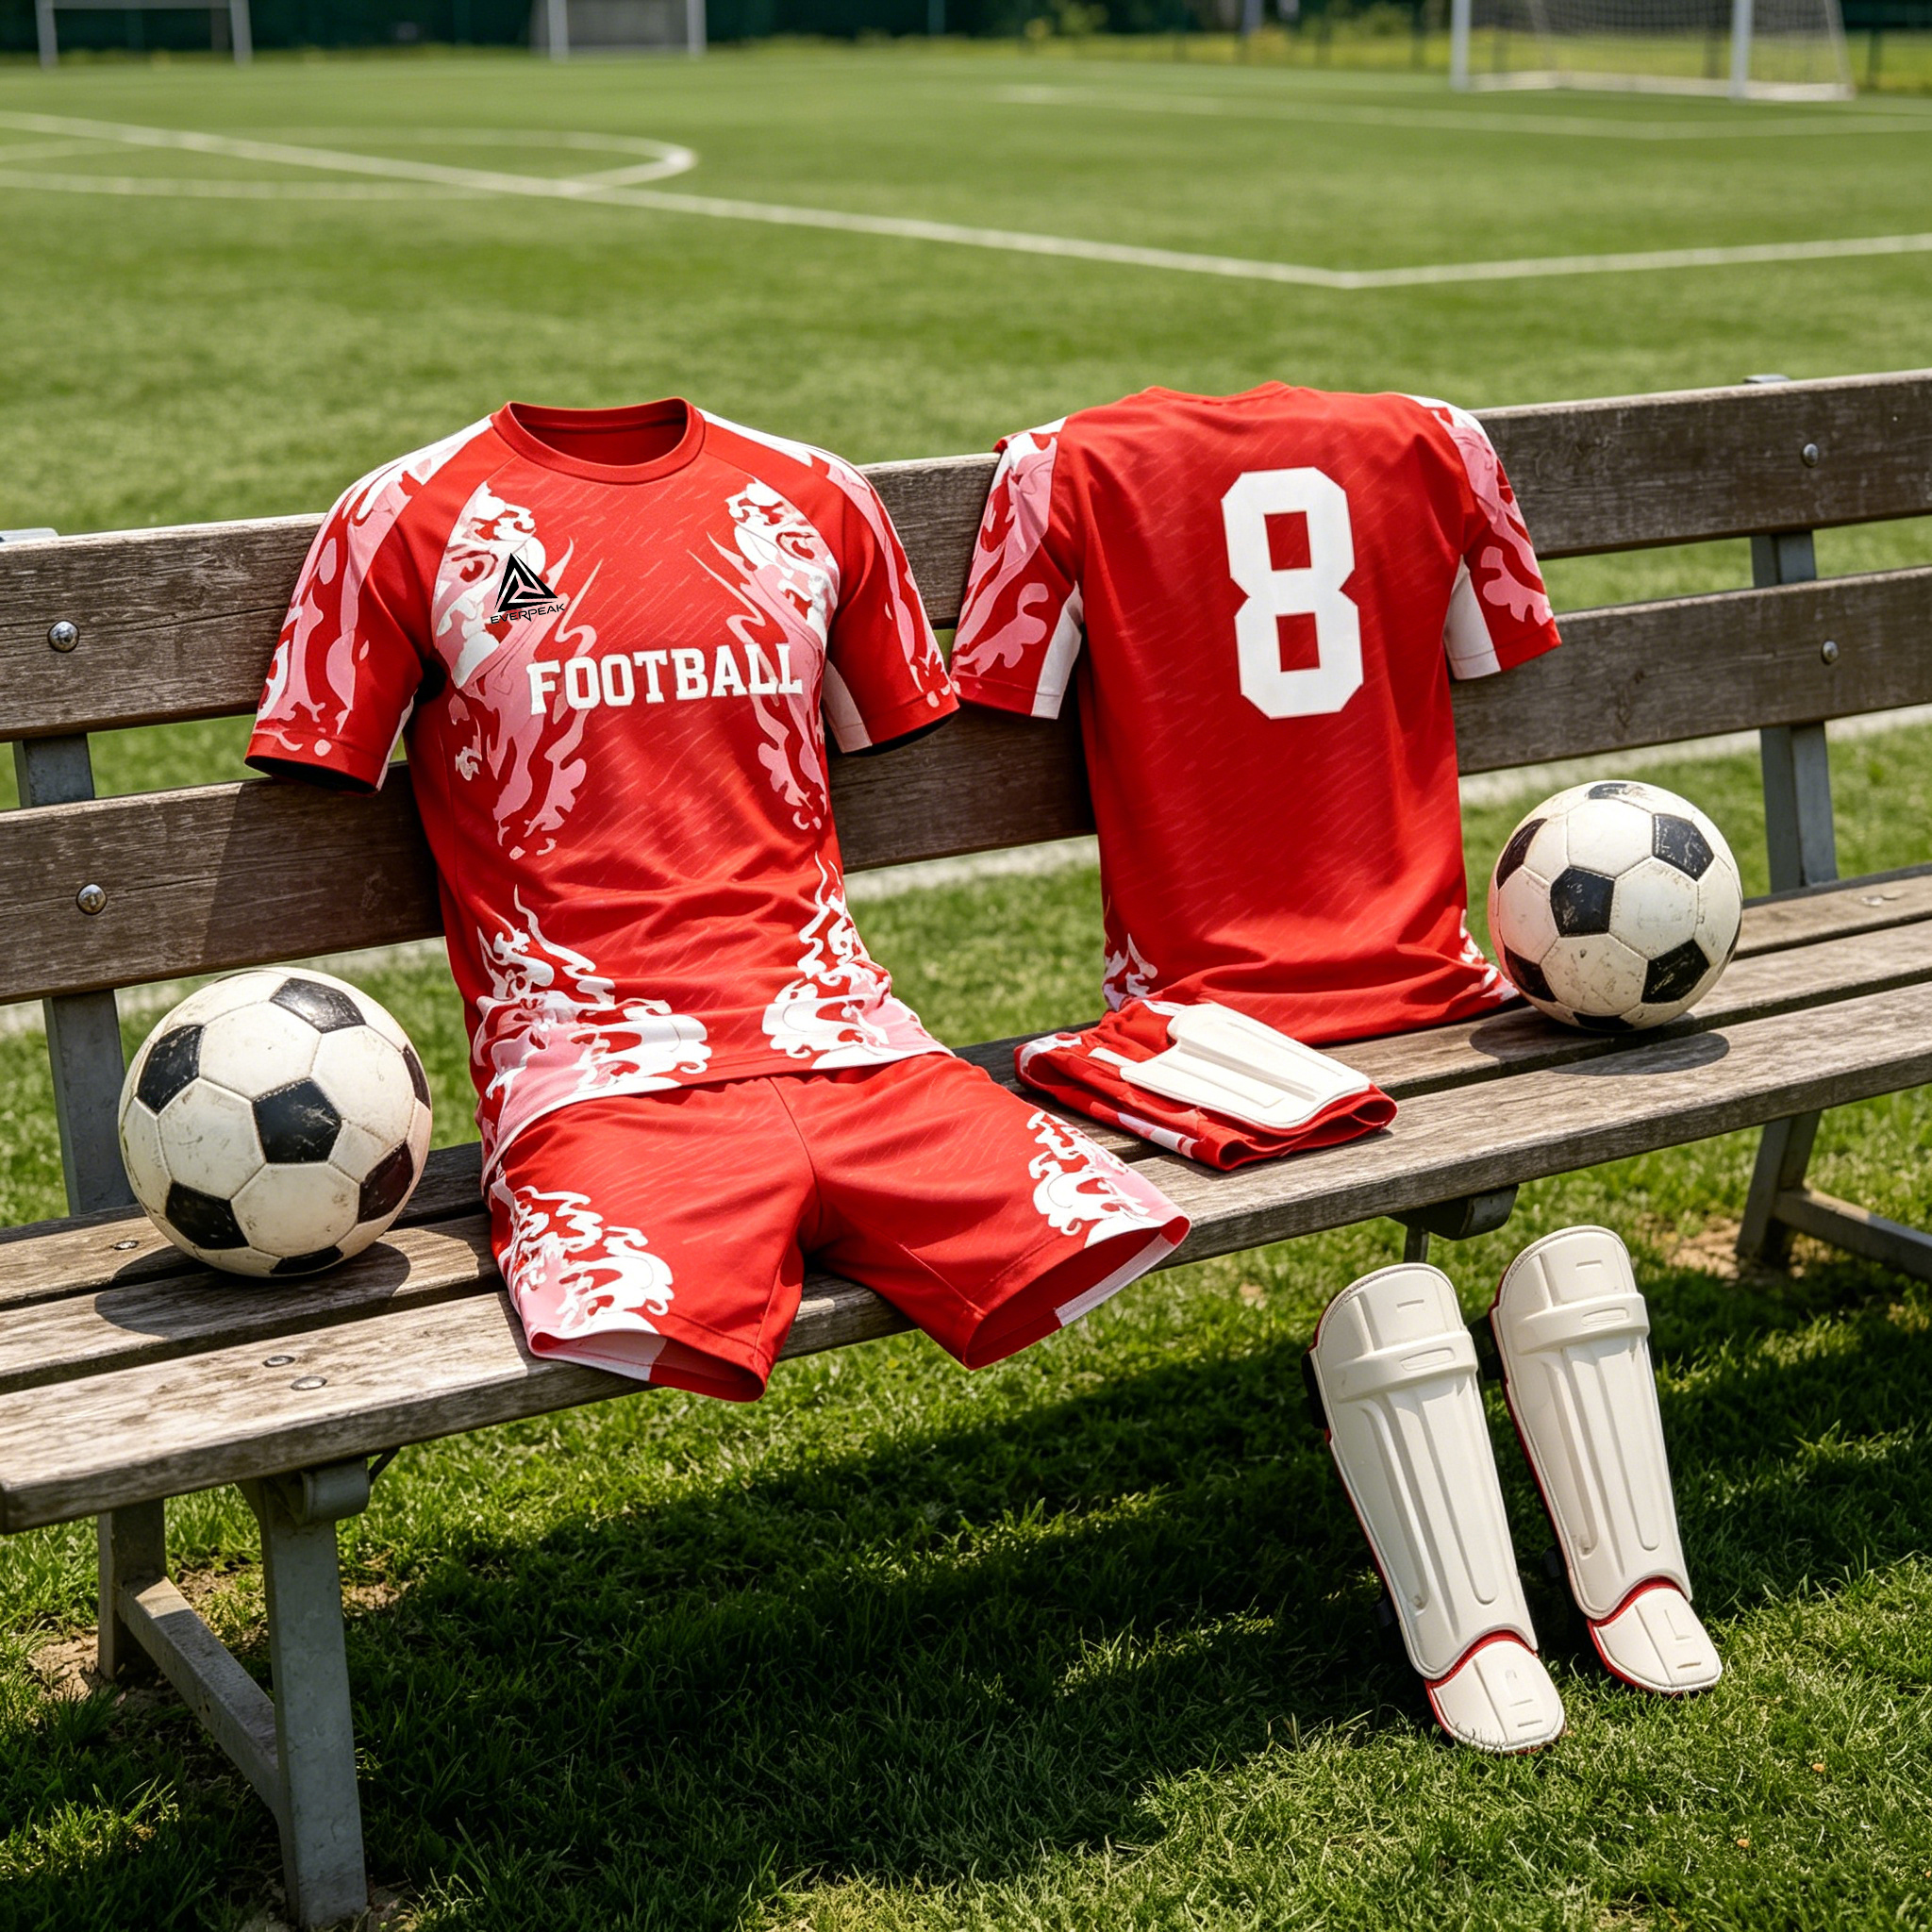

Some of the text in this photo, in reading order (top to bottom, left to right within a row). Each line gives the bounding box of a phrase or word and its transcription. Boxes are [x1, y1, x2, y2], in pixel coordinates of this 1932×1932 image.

[490, 603, 566, 625] EVERPEAK
[1221, 467, 1363, 719] 8
[526, 642, 804, 716] FOOTBALL
